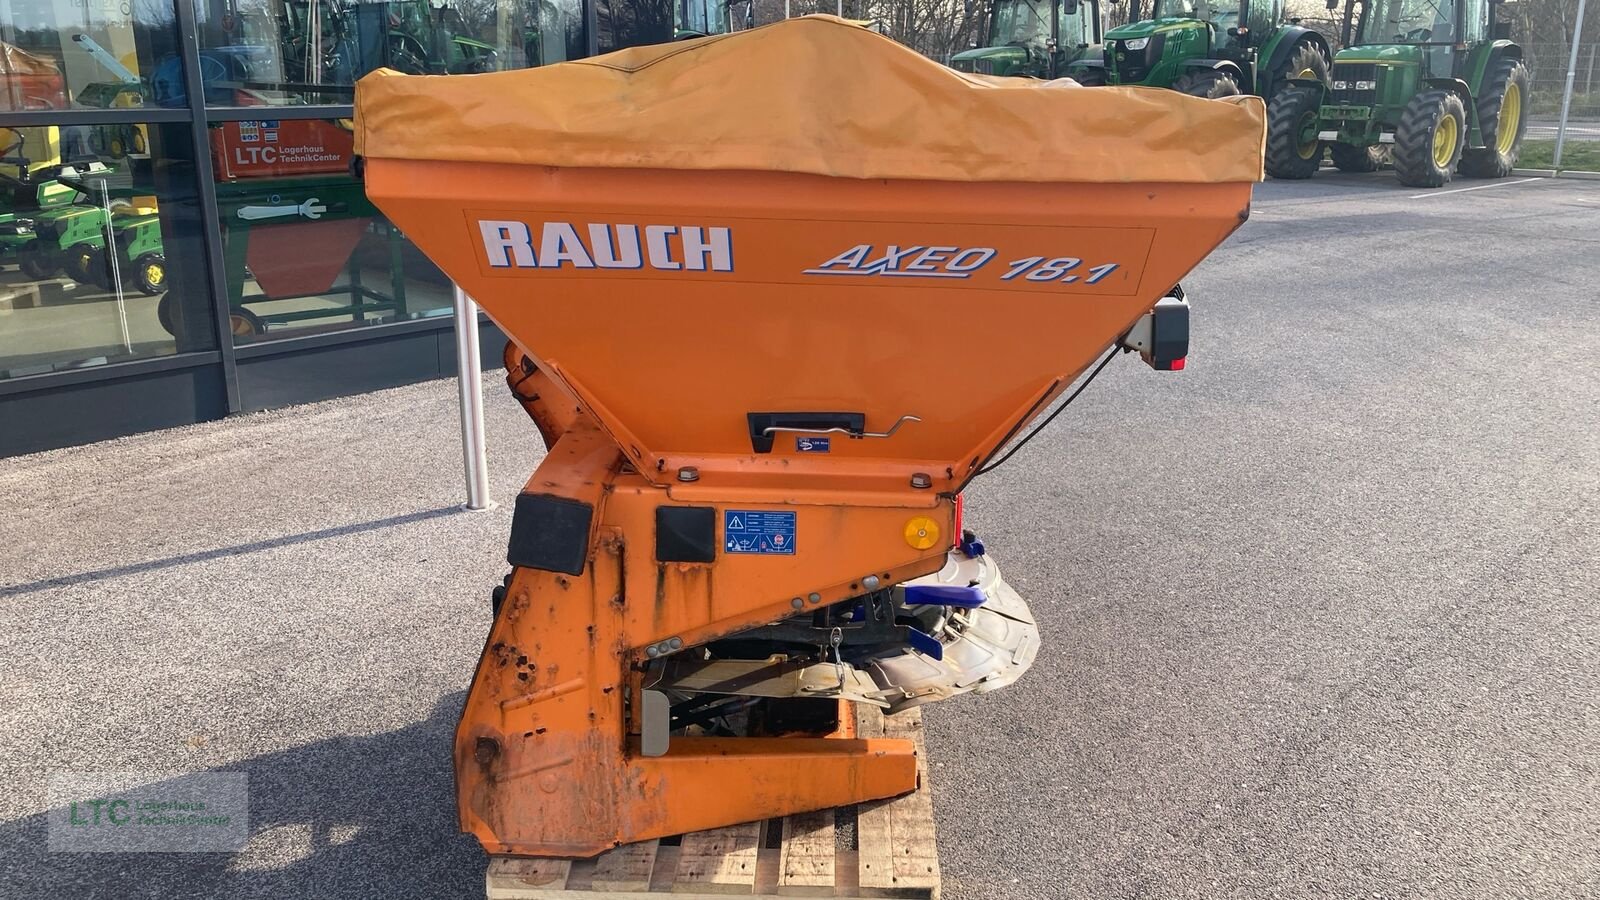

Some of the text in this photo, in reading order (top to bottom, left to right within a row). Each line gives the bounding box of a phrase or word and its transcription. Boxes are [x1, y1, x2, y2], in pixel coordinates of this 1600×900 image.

[235, 147, 277, 165] LTC
[279, 145, 324, 155] Lagerhaus
[279, 154, 341, 163] TechnikCenter
[478, 219, 734, 272] RAUCH
[814, 244, 1120, 284] AXEO 18.1
